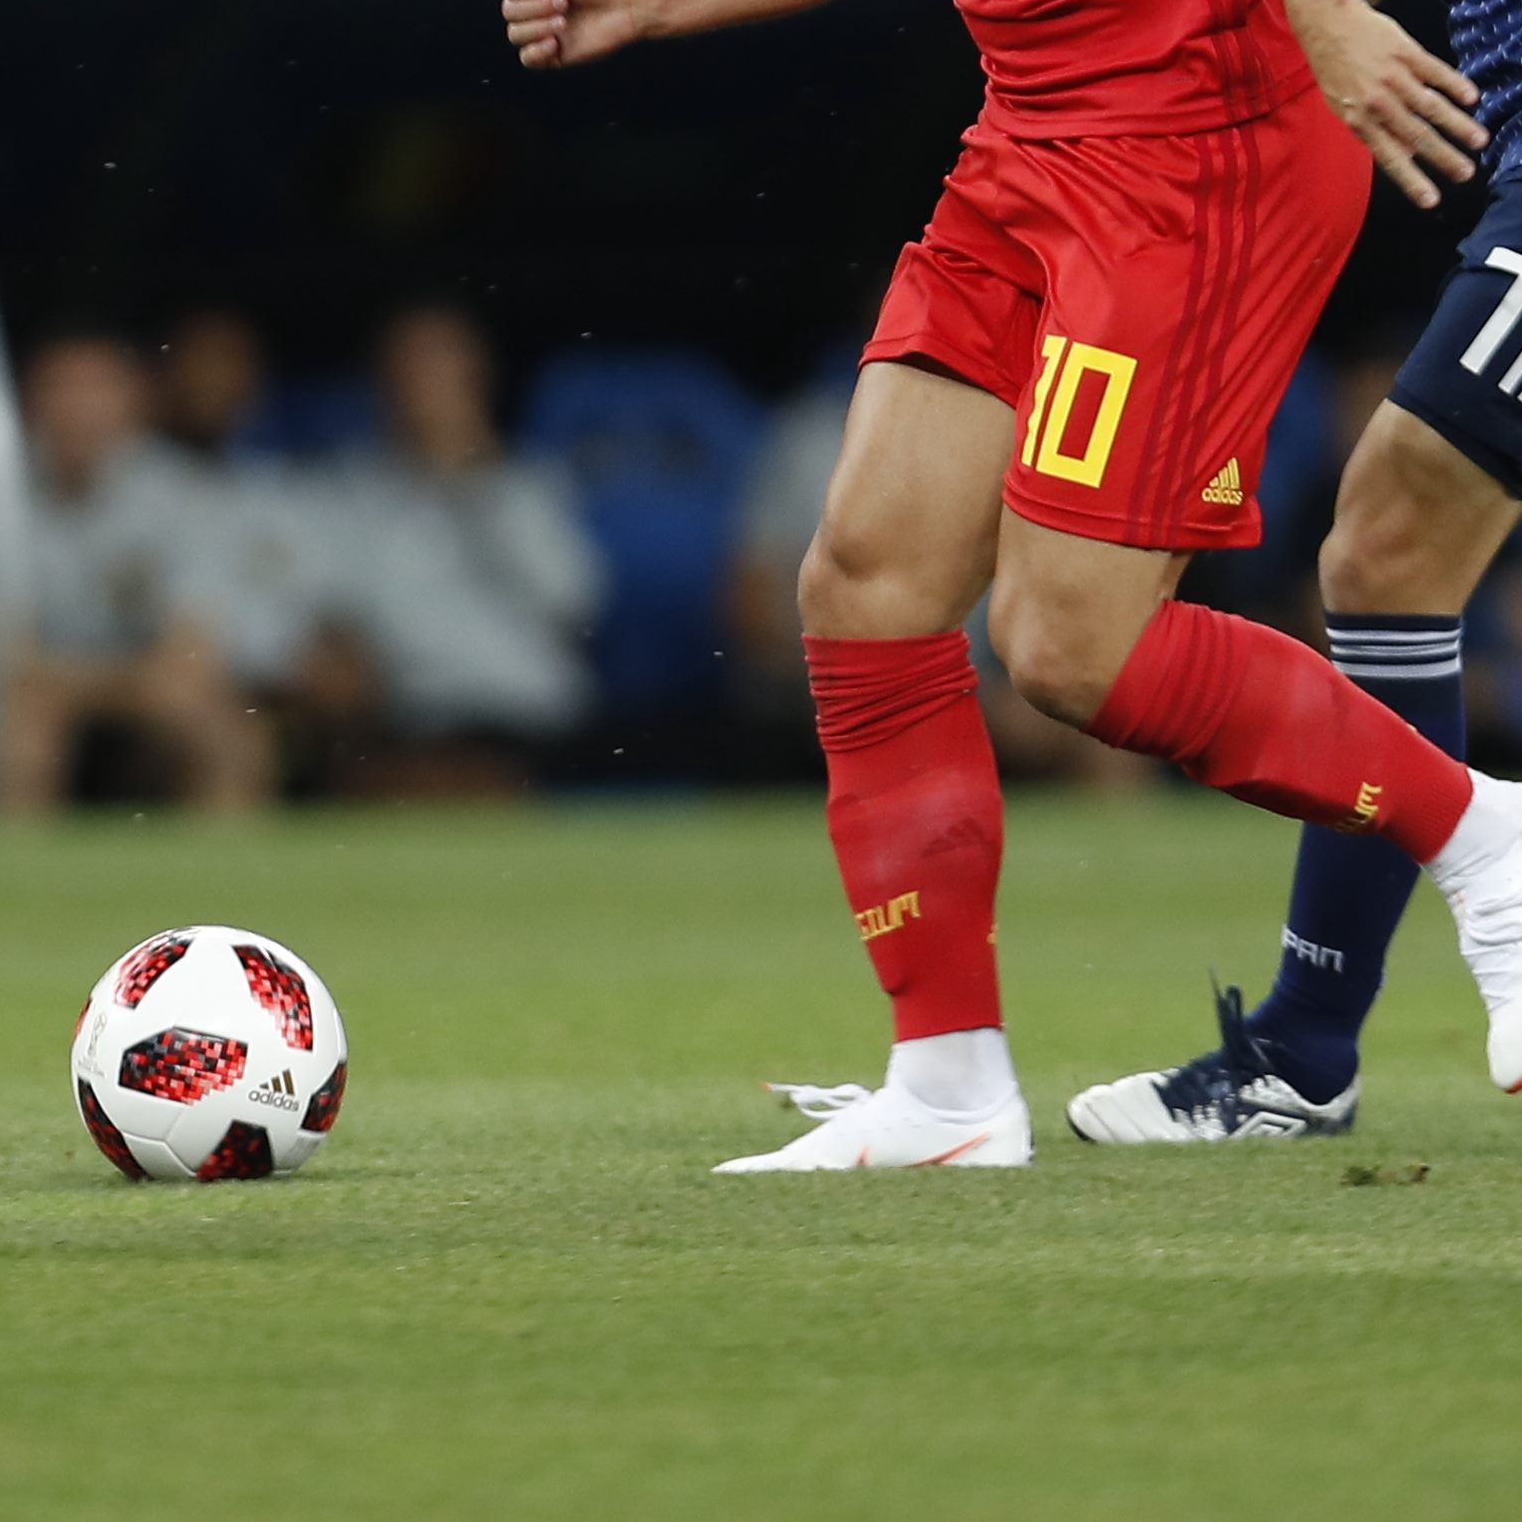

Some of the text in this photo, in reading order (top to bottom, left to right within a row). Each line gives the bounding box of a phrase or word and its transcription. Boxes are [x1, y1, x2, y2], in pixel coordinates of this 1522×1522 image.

[1021, 334, 1138, 489] 10
[1201, 487, 1244, 506] adidas
[247, 1089, 300, 1112] adidas
